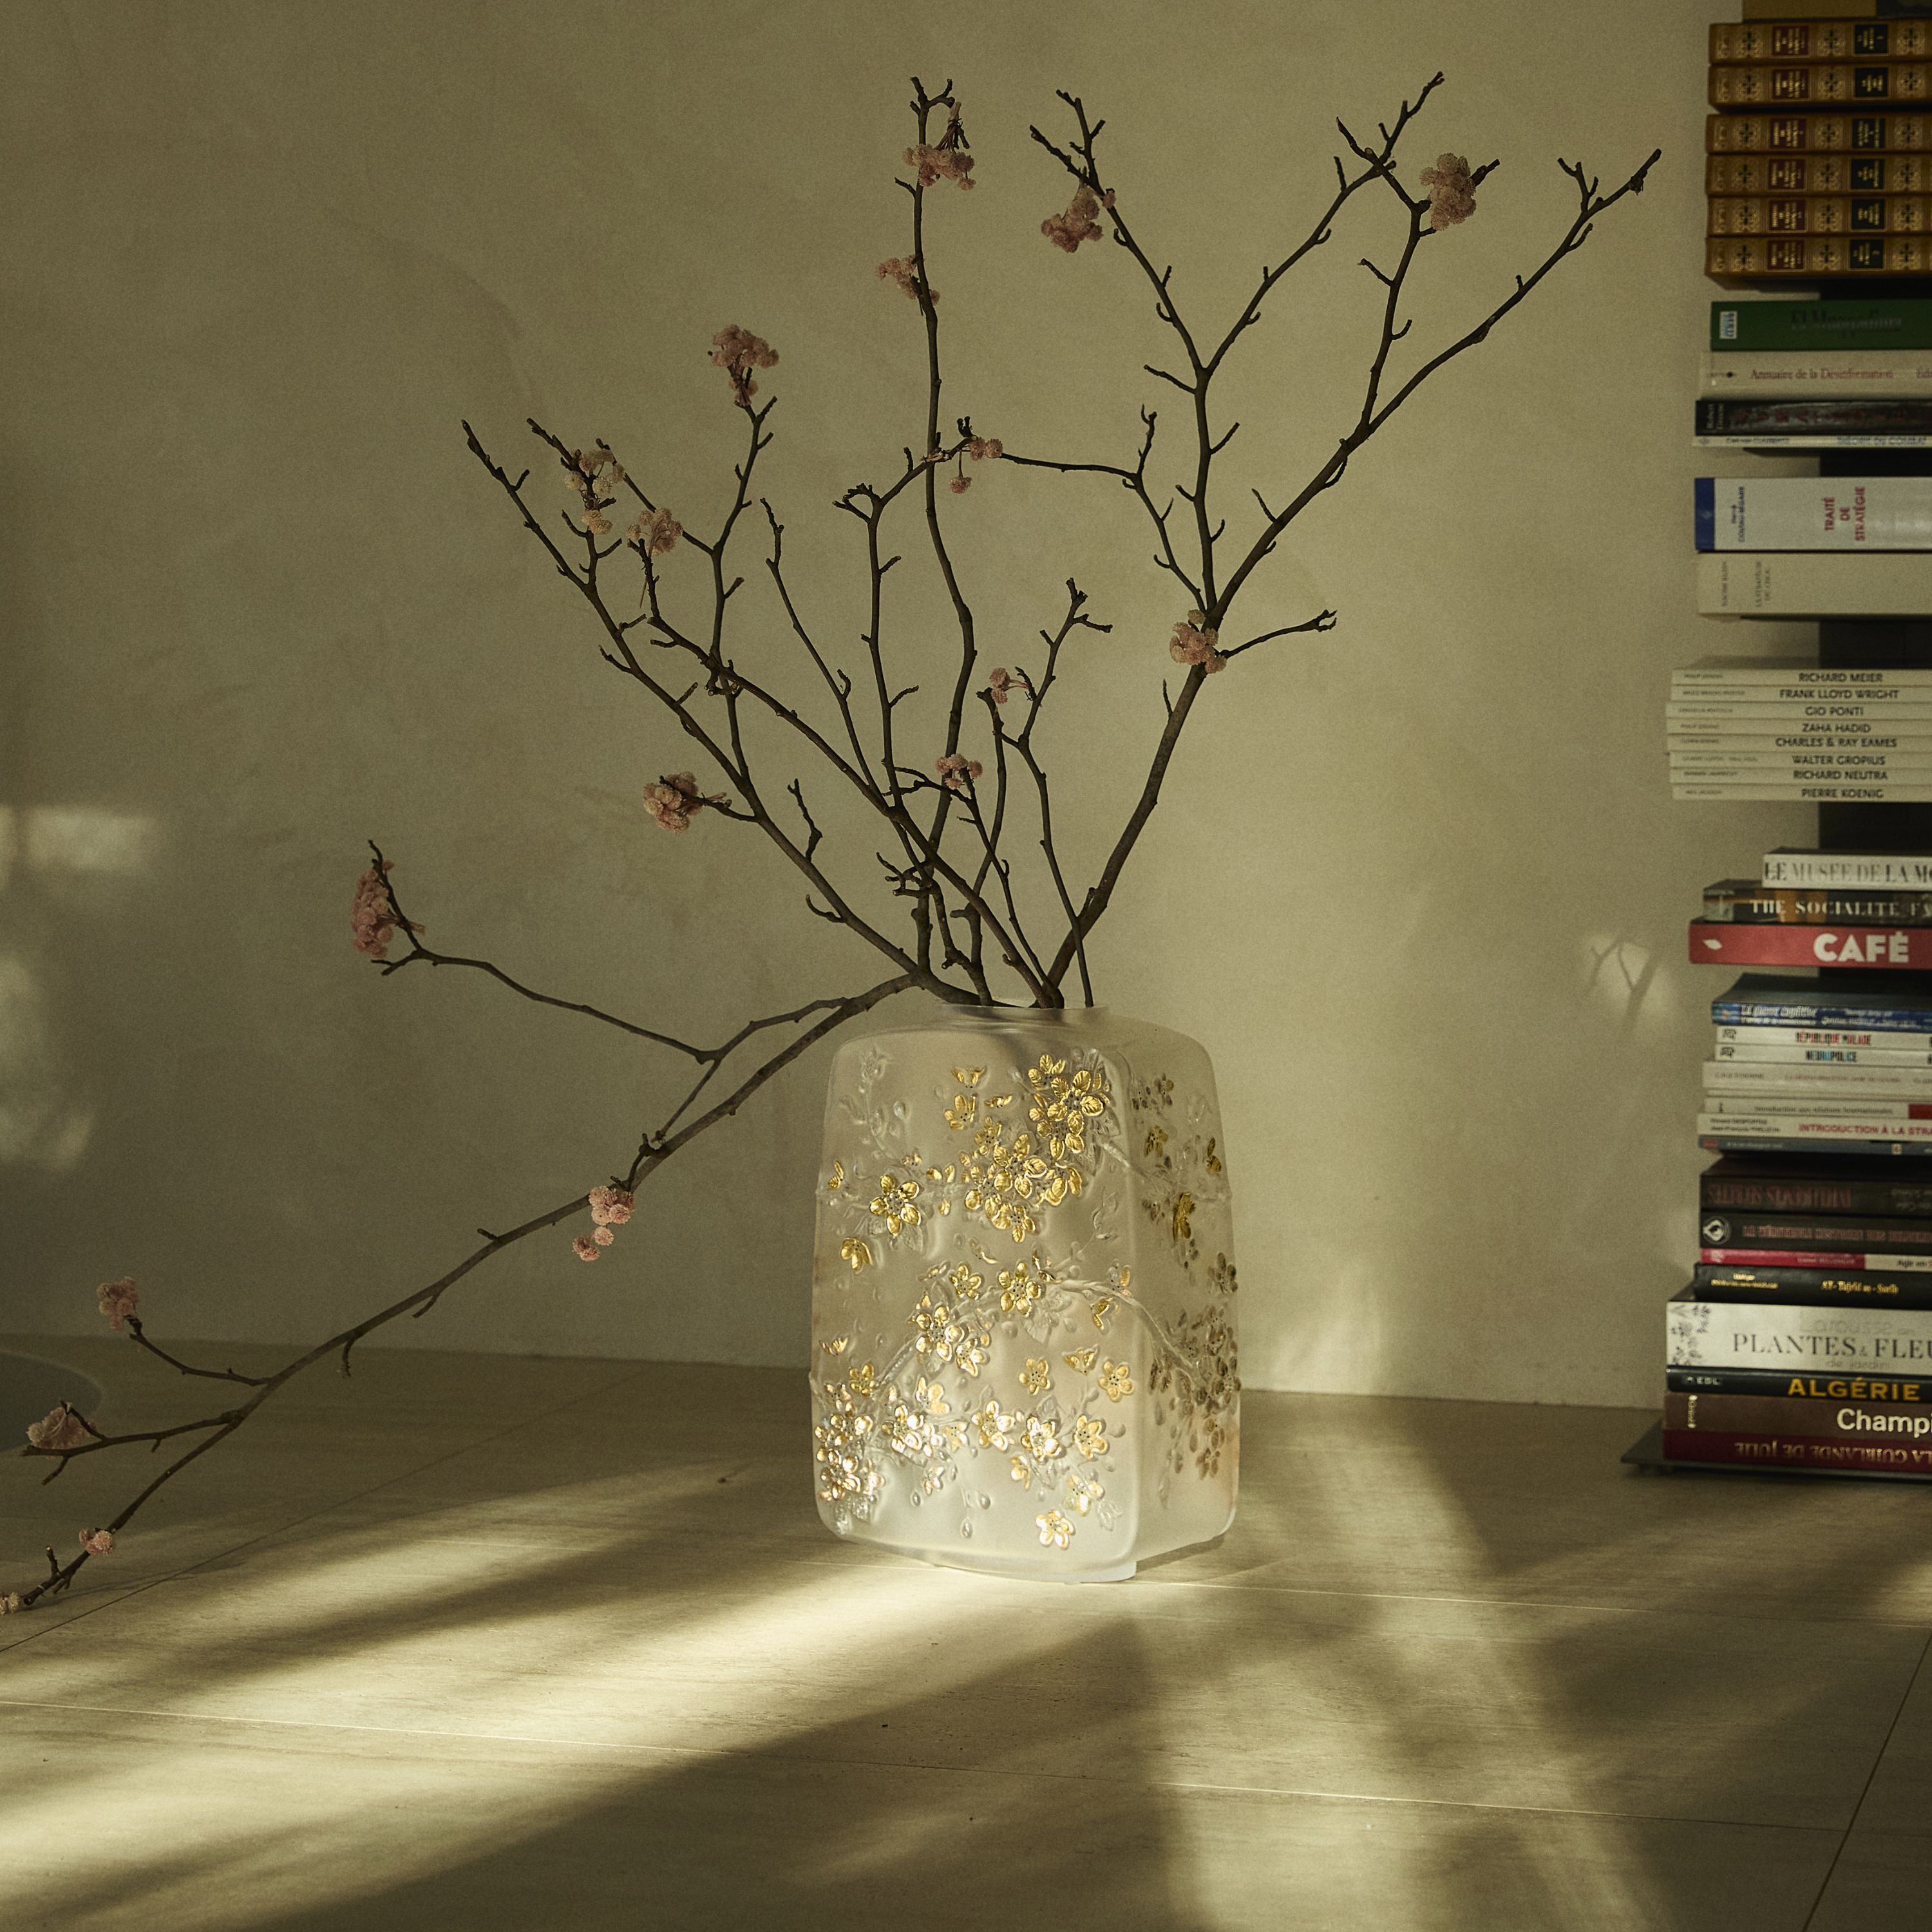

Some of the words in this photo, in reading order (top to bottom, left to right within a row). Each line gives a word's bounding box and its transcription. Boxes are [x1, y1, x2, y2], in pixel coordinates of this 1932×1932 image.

[1821, 497, 1835, 531] TRAITÉ
[1840, 507, 1850, 521] DE
[1852, 486, 1866, 541] STRATÉGIE
[1799, 672, 1847, 682] RICHARD
[1850, 673, 1883, 682] MEIER
[1779, 689, 1815, 699] FRANK
[1817, 689, 1853, 699] LLOYD
[1855, 690, 1899, 699] WRIGHT
[1805, 706, 1826, 716] GIO
[1829, 706, 1864, 716] PONTI
[1802, 723, 1832, 733] ZAHA
[1835, 723, 1871, 733] HADID
[1776, 737, 1823, 747] CHARLES
[1826, 737, 1834, 747] &
[1838, 738, 1857, 747] RAY
[1861, 738, 1897, 748] EAMES
[1792, 755, 1833, 764] WALTER
[1837, 755, 1886, 766] GROPIUS
[1794, 770, 1841, 779] RICHARD
[1844, 770, 1888, 780] NEUTRA
[1802, 788, 1837, 797] PIERRE
[1841, 789, 1884, 799] KOENIG
[1885, 864, 1908, 882] LA
[1750, 899, 1786, 914] THE
[1795, 901, 1899, 916] SOCIALITE
[1814, 931, 1909, 963] CAFÉ
[1796, 1030, 1839, 1045] RÉPUBLIQUE
[1799, 1124, 1878, 1134] INTRODUCTION
[1881, 1123, 1888, 1134] À
[1733, 1333, 1856, 1356] PLANTES
[1787, 1376, 1920, 1401] ALGÉRIE
[1837, 1408, 1932, 1438] Champ
[1735, 1440, 1777, 1457] JULIE
[1782, 1444, 1804, 1458] DE
[1810, 1445, 1908, 1463] GUIRLANDE
